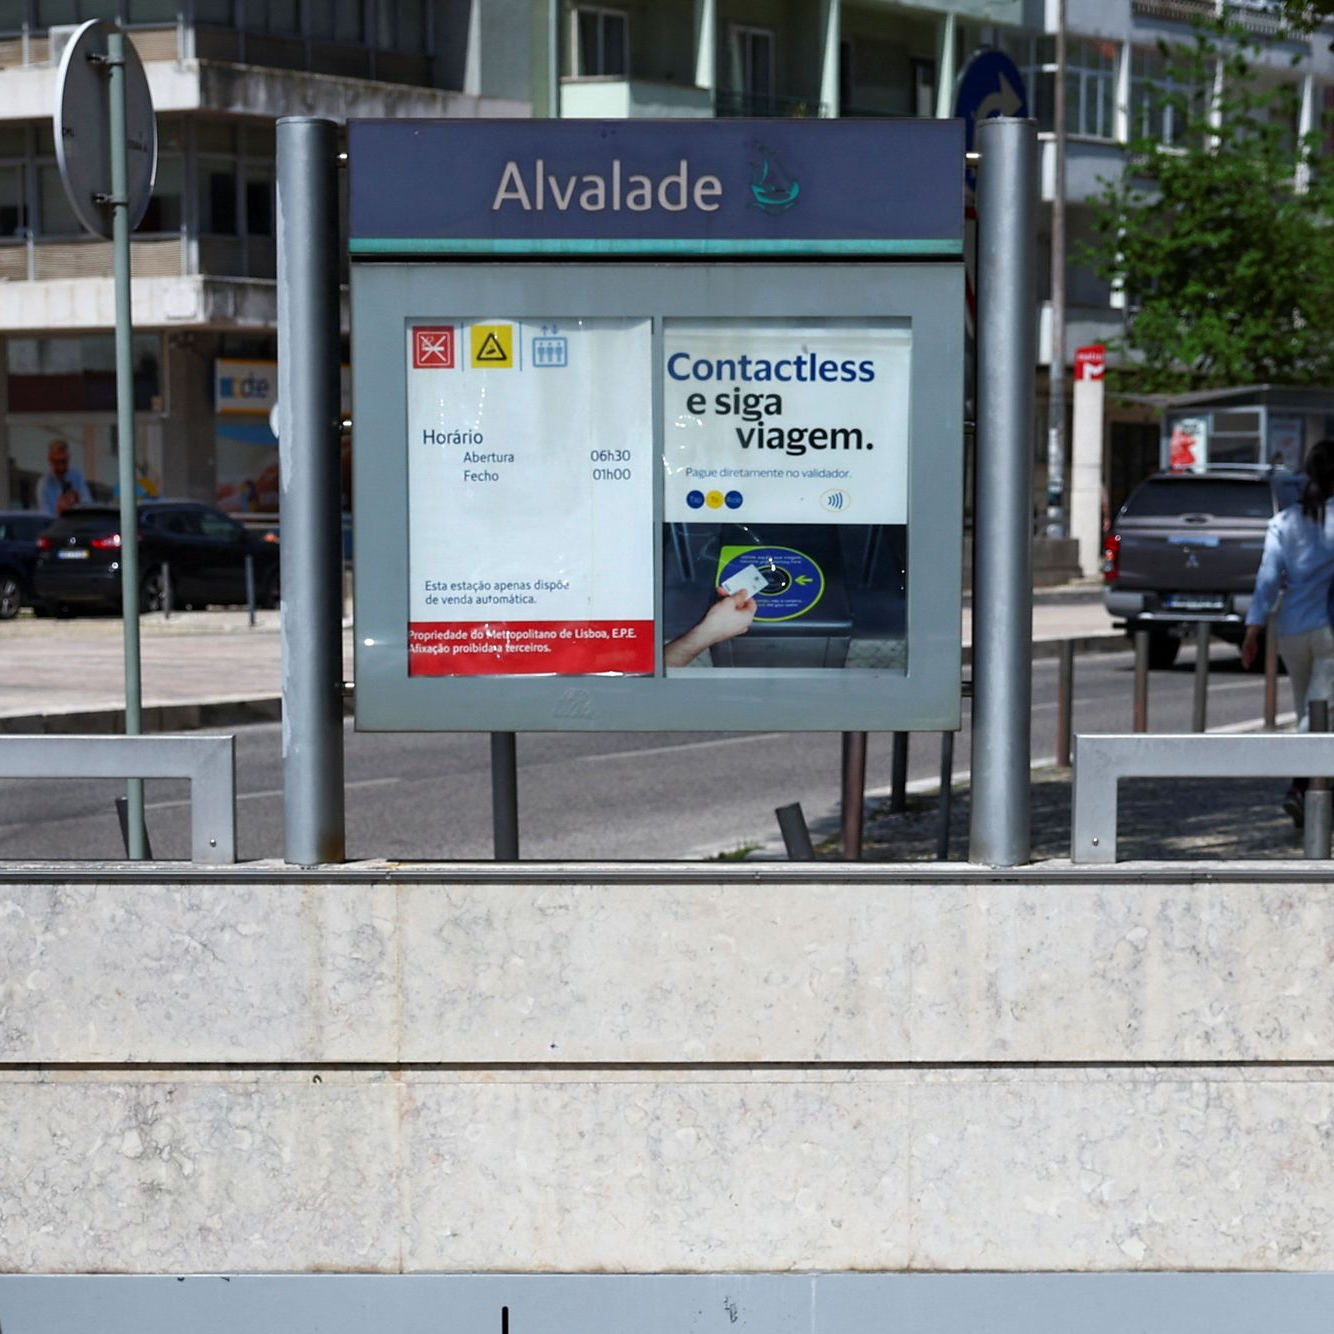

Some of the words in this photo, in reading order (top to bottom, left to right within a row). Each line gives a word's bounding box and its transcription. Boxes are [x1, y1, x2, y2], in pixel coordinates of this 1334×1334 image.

[492, 159, 723, 211] Alvalade
[667, 352, 875, 382] Contactless
[686, 392, 706, 415] e
[714, 386, 783, 422] siga
[422, 429, 484, 445] Horário
[735, 420, 874, 456] viagem.
[463, 451, 515, 463] Abertura
[590, 449, 631, 462] 06h30
[463, 469, 500, 482] Fecho
[592, 468, 632, 481] 01h00
[685, 467, 718, 480] Pague
[719, 466, 784, 479] diretamente
[785, 470, 800, 479] no
[801, 467, 852, 479] validador.
[424, 581, 448, 592] Esta
[449, 581, 491, 594] estação
[493, 583, 532, 594] apenas
[425, 594, 439, 605] de
[441, 594, 474, 605] venda
[475, 593, 538, 605] automática.
[470, 630, 484, 639] do
[559, 629, 573, 639] de
[574, 629, 610, 640] Lisboa,
[611, 628, 638, 639] E.P.E.
[504, 642, 552, 653] terceiros.
